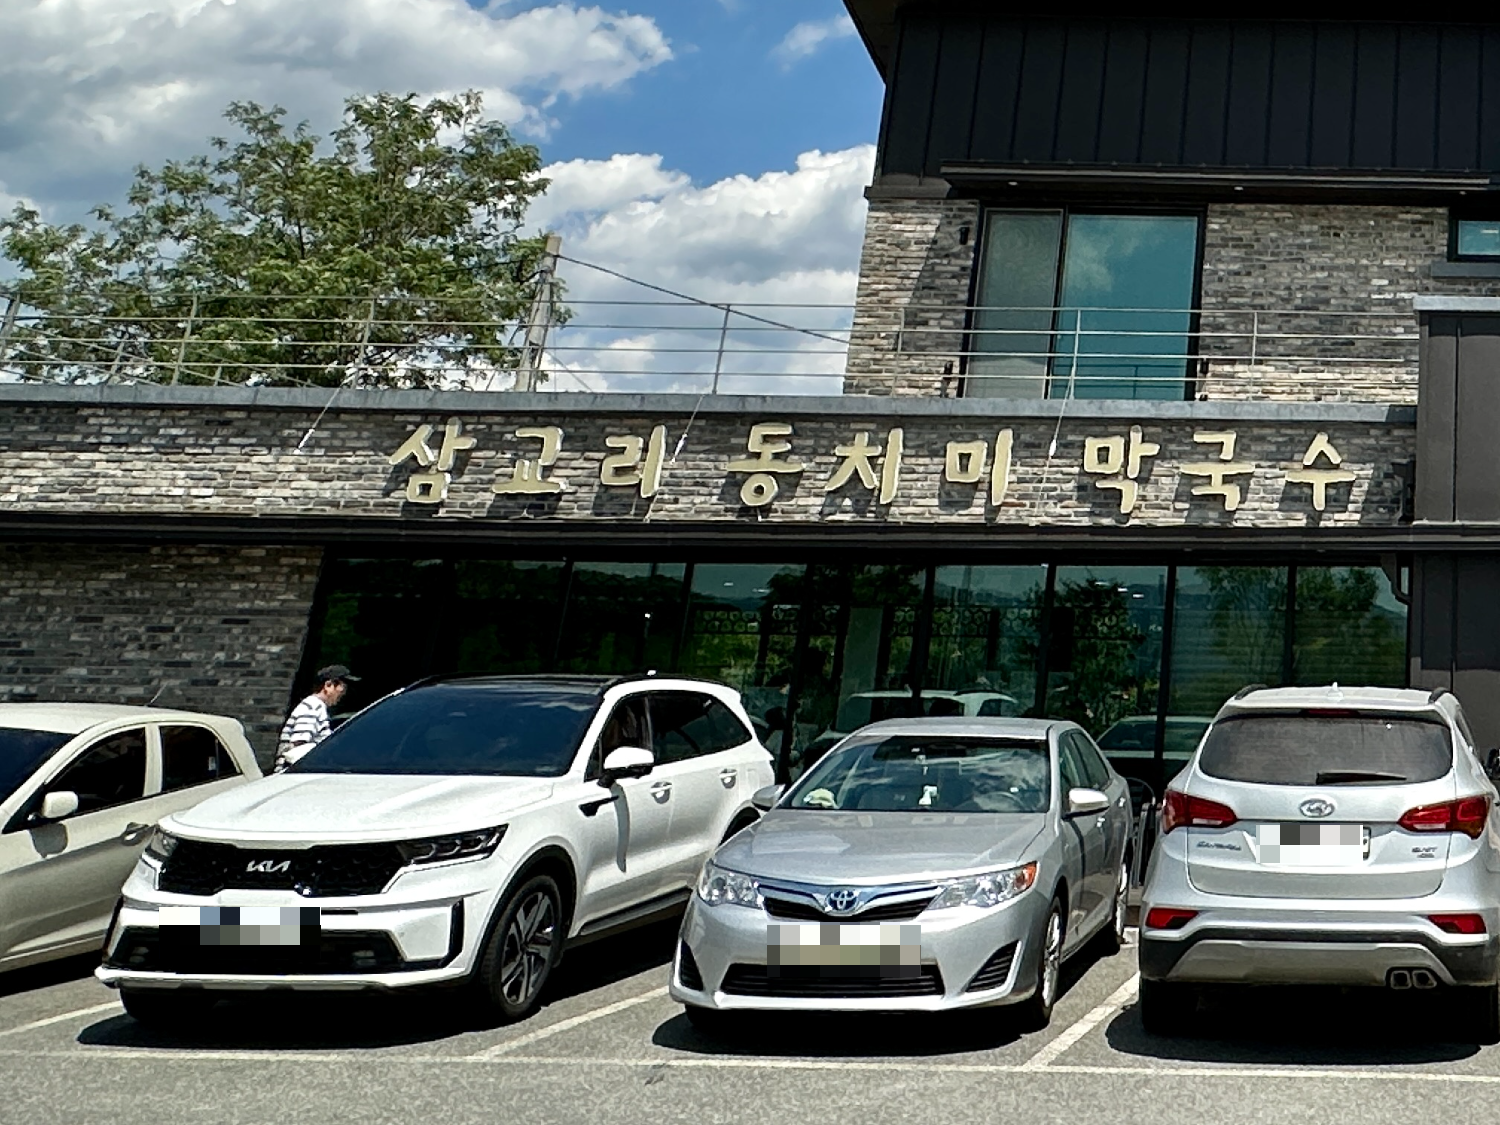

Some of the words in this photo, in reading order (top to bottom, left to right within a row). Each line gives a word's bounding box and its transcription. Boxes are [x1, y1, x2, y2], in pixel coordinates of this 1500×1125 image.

[387, 417, 666, 504] 삼교리
[726, 421, 1013, 506] 동치미
[1083, 425, 1356, 514] 막국수
